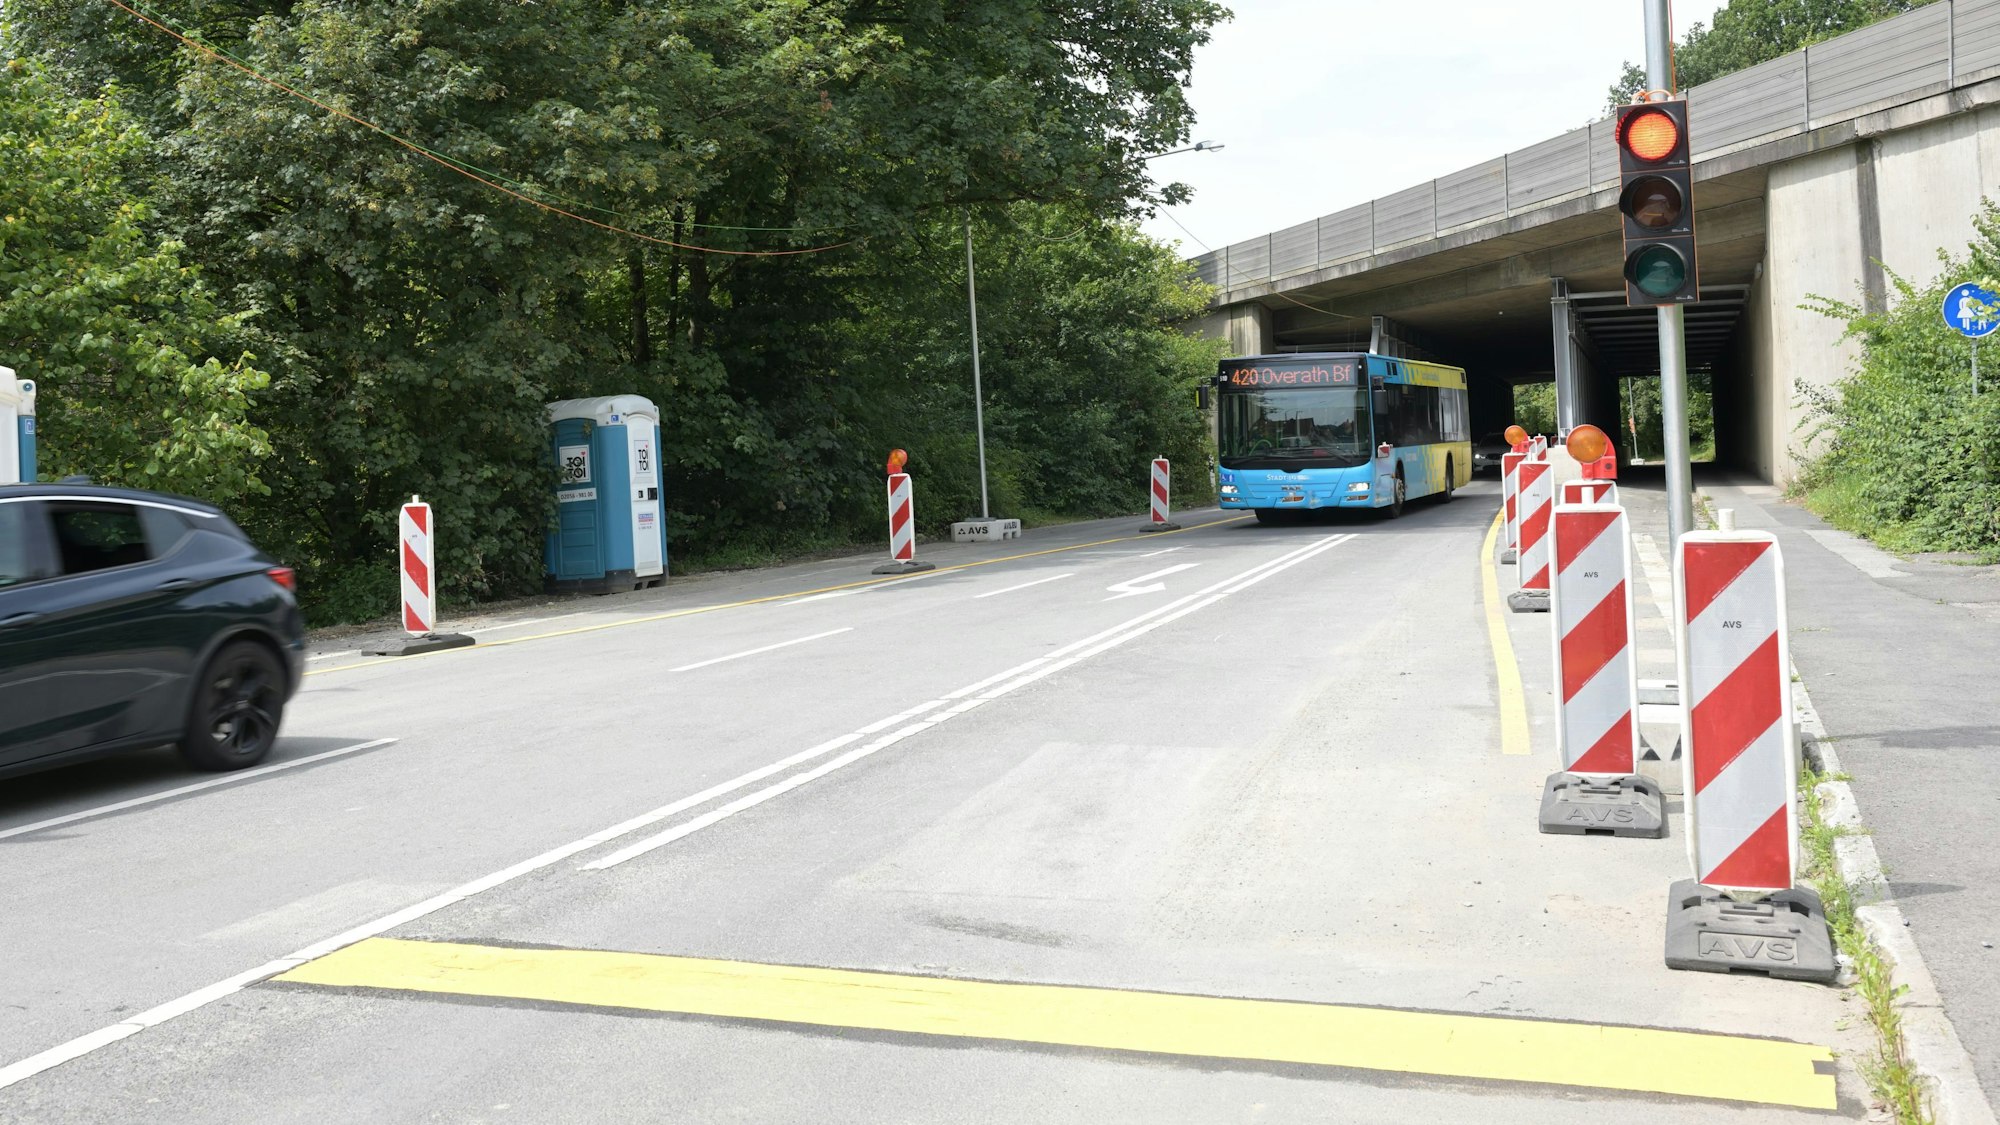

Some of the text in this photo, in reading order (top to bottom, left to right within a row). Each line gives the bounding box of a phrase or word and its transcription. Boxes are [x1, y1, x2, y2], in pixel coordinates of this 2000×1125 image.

[1232, 365, 1352, 385] 420 Overath Bf
[638, 449, 648, 460] TOI
[567, 456, 586, 467] TOI
[639, 460, 649, 471] TOI
[968, 526, 989, 534] AVS
[1722, 620, 1742, 629] AVS
[1566, 807, 1635, 823] AVS
[1701, 937, 1795, 962] AVS
